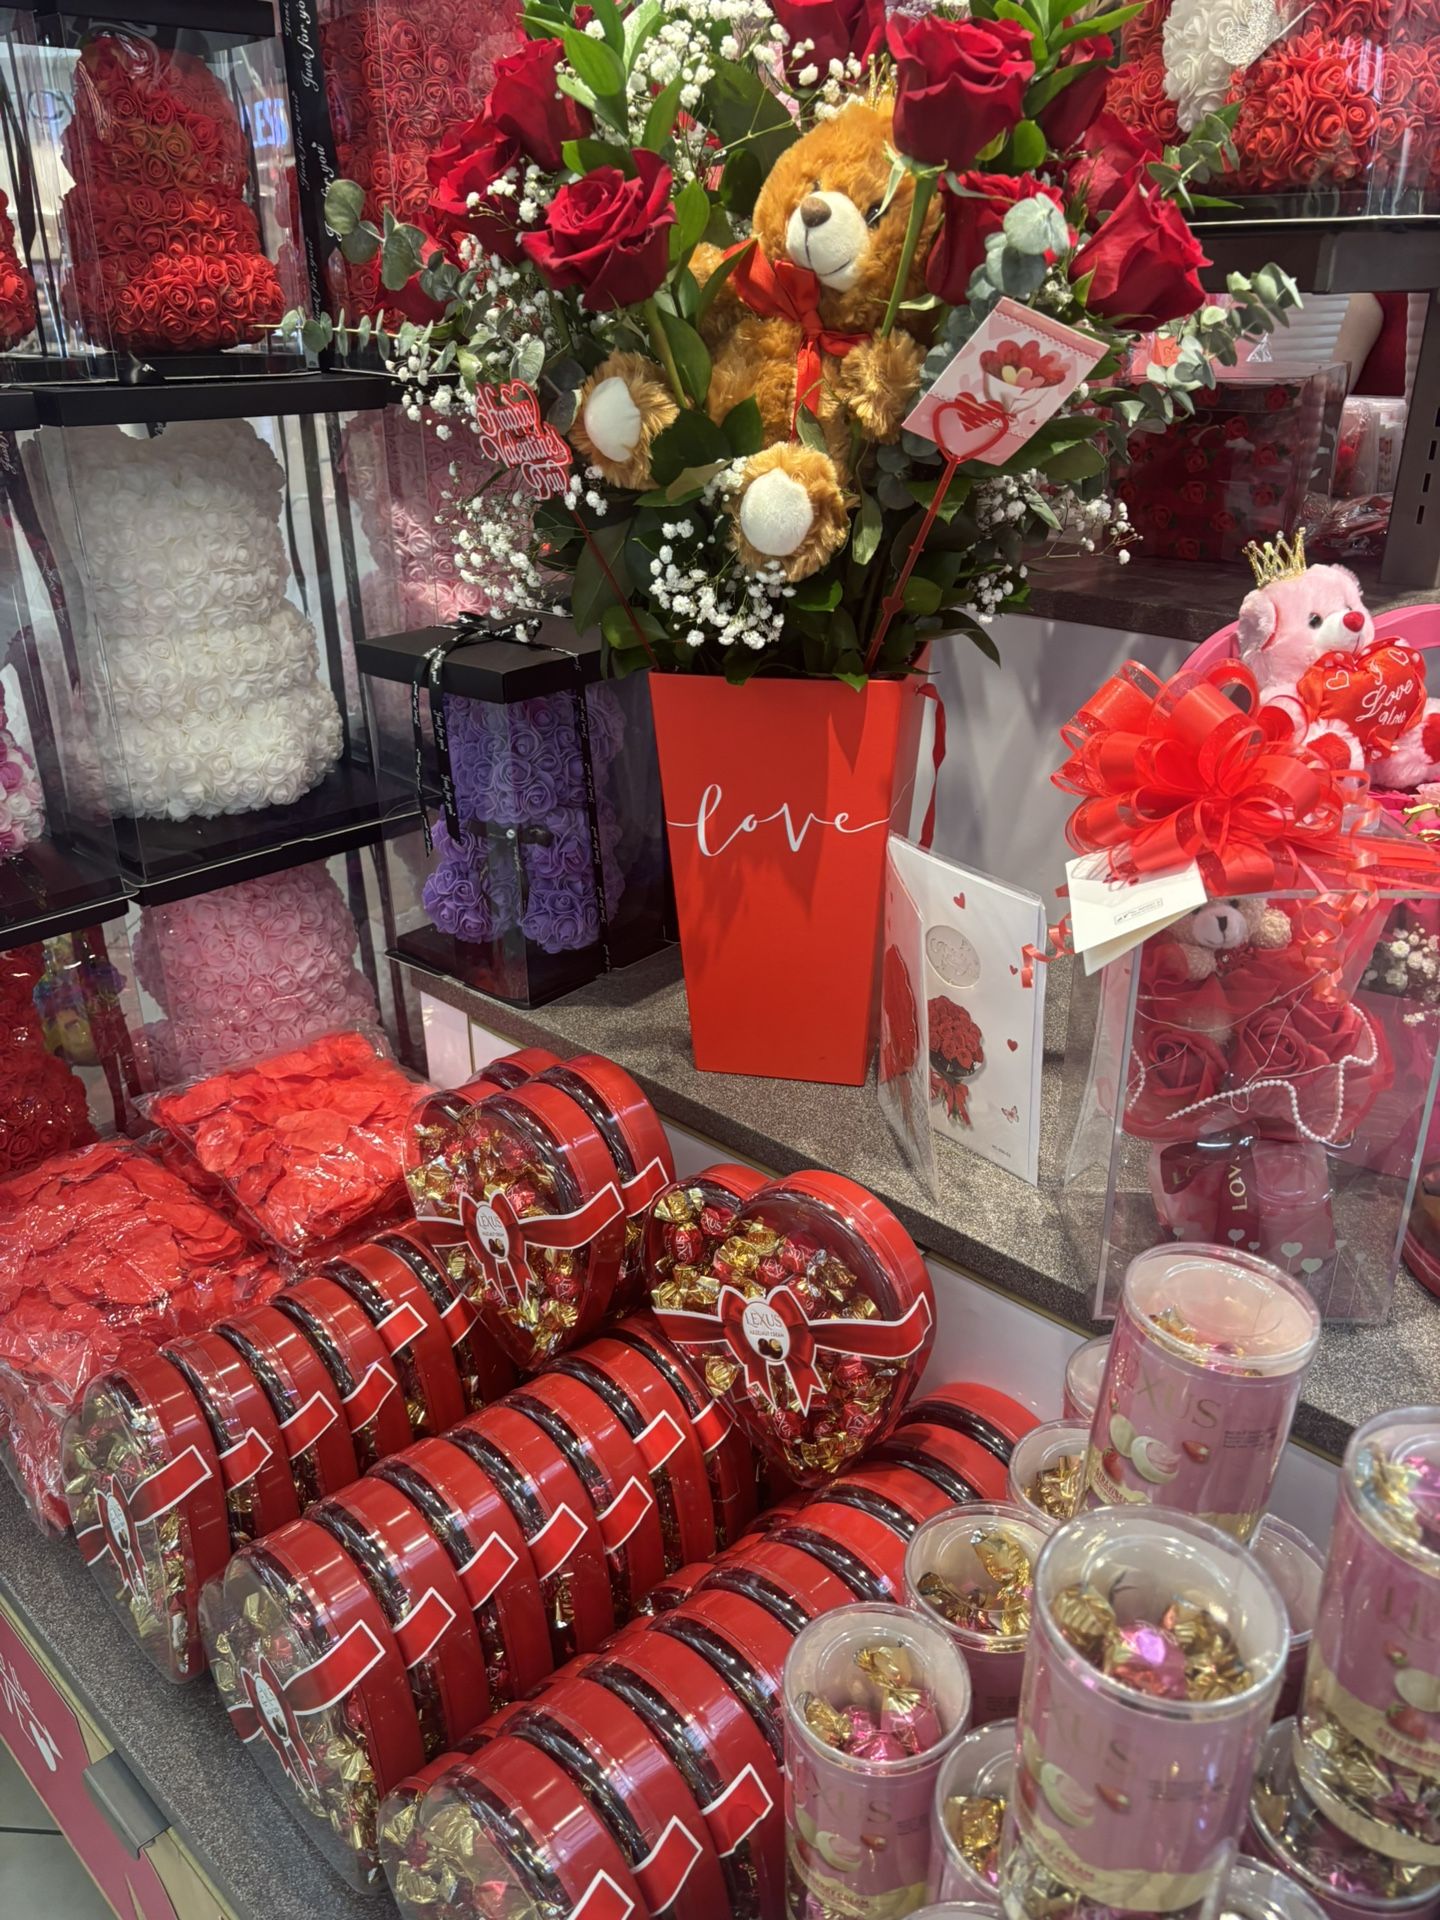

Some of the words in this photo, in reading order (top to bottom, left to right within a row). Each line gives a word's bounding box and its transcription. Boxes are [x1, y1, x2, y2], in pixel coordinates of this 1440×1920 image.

[296, 0, 311, 25] yo
[297, 24, 316, 58] for
[299, 53, 320, 92] Just
[315, 145, 335, 178] you
[477, 382, 541, 438] Happy
[480, 424, 570, 470] Valentine's
[521, 459, 568, 500] Day
[1355, 679, 1414, 722] Love
[1378, 706, 1407, 725] You
[666, 783, 890, 857] love
[1228, 1156, 1248, 1211] LOV
[478, 1213, 503, 1231] LEXUS
[745, 1310, 783, 1330] LEXUS
